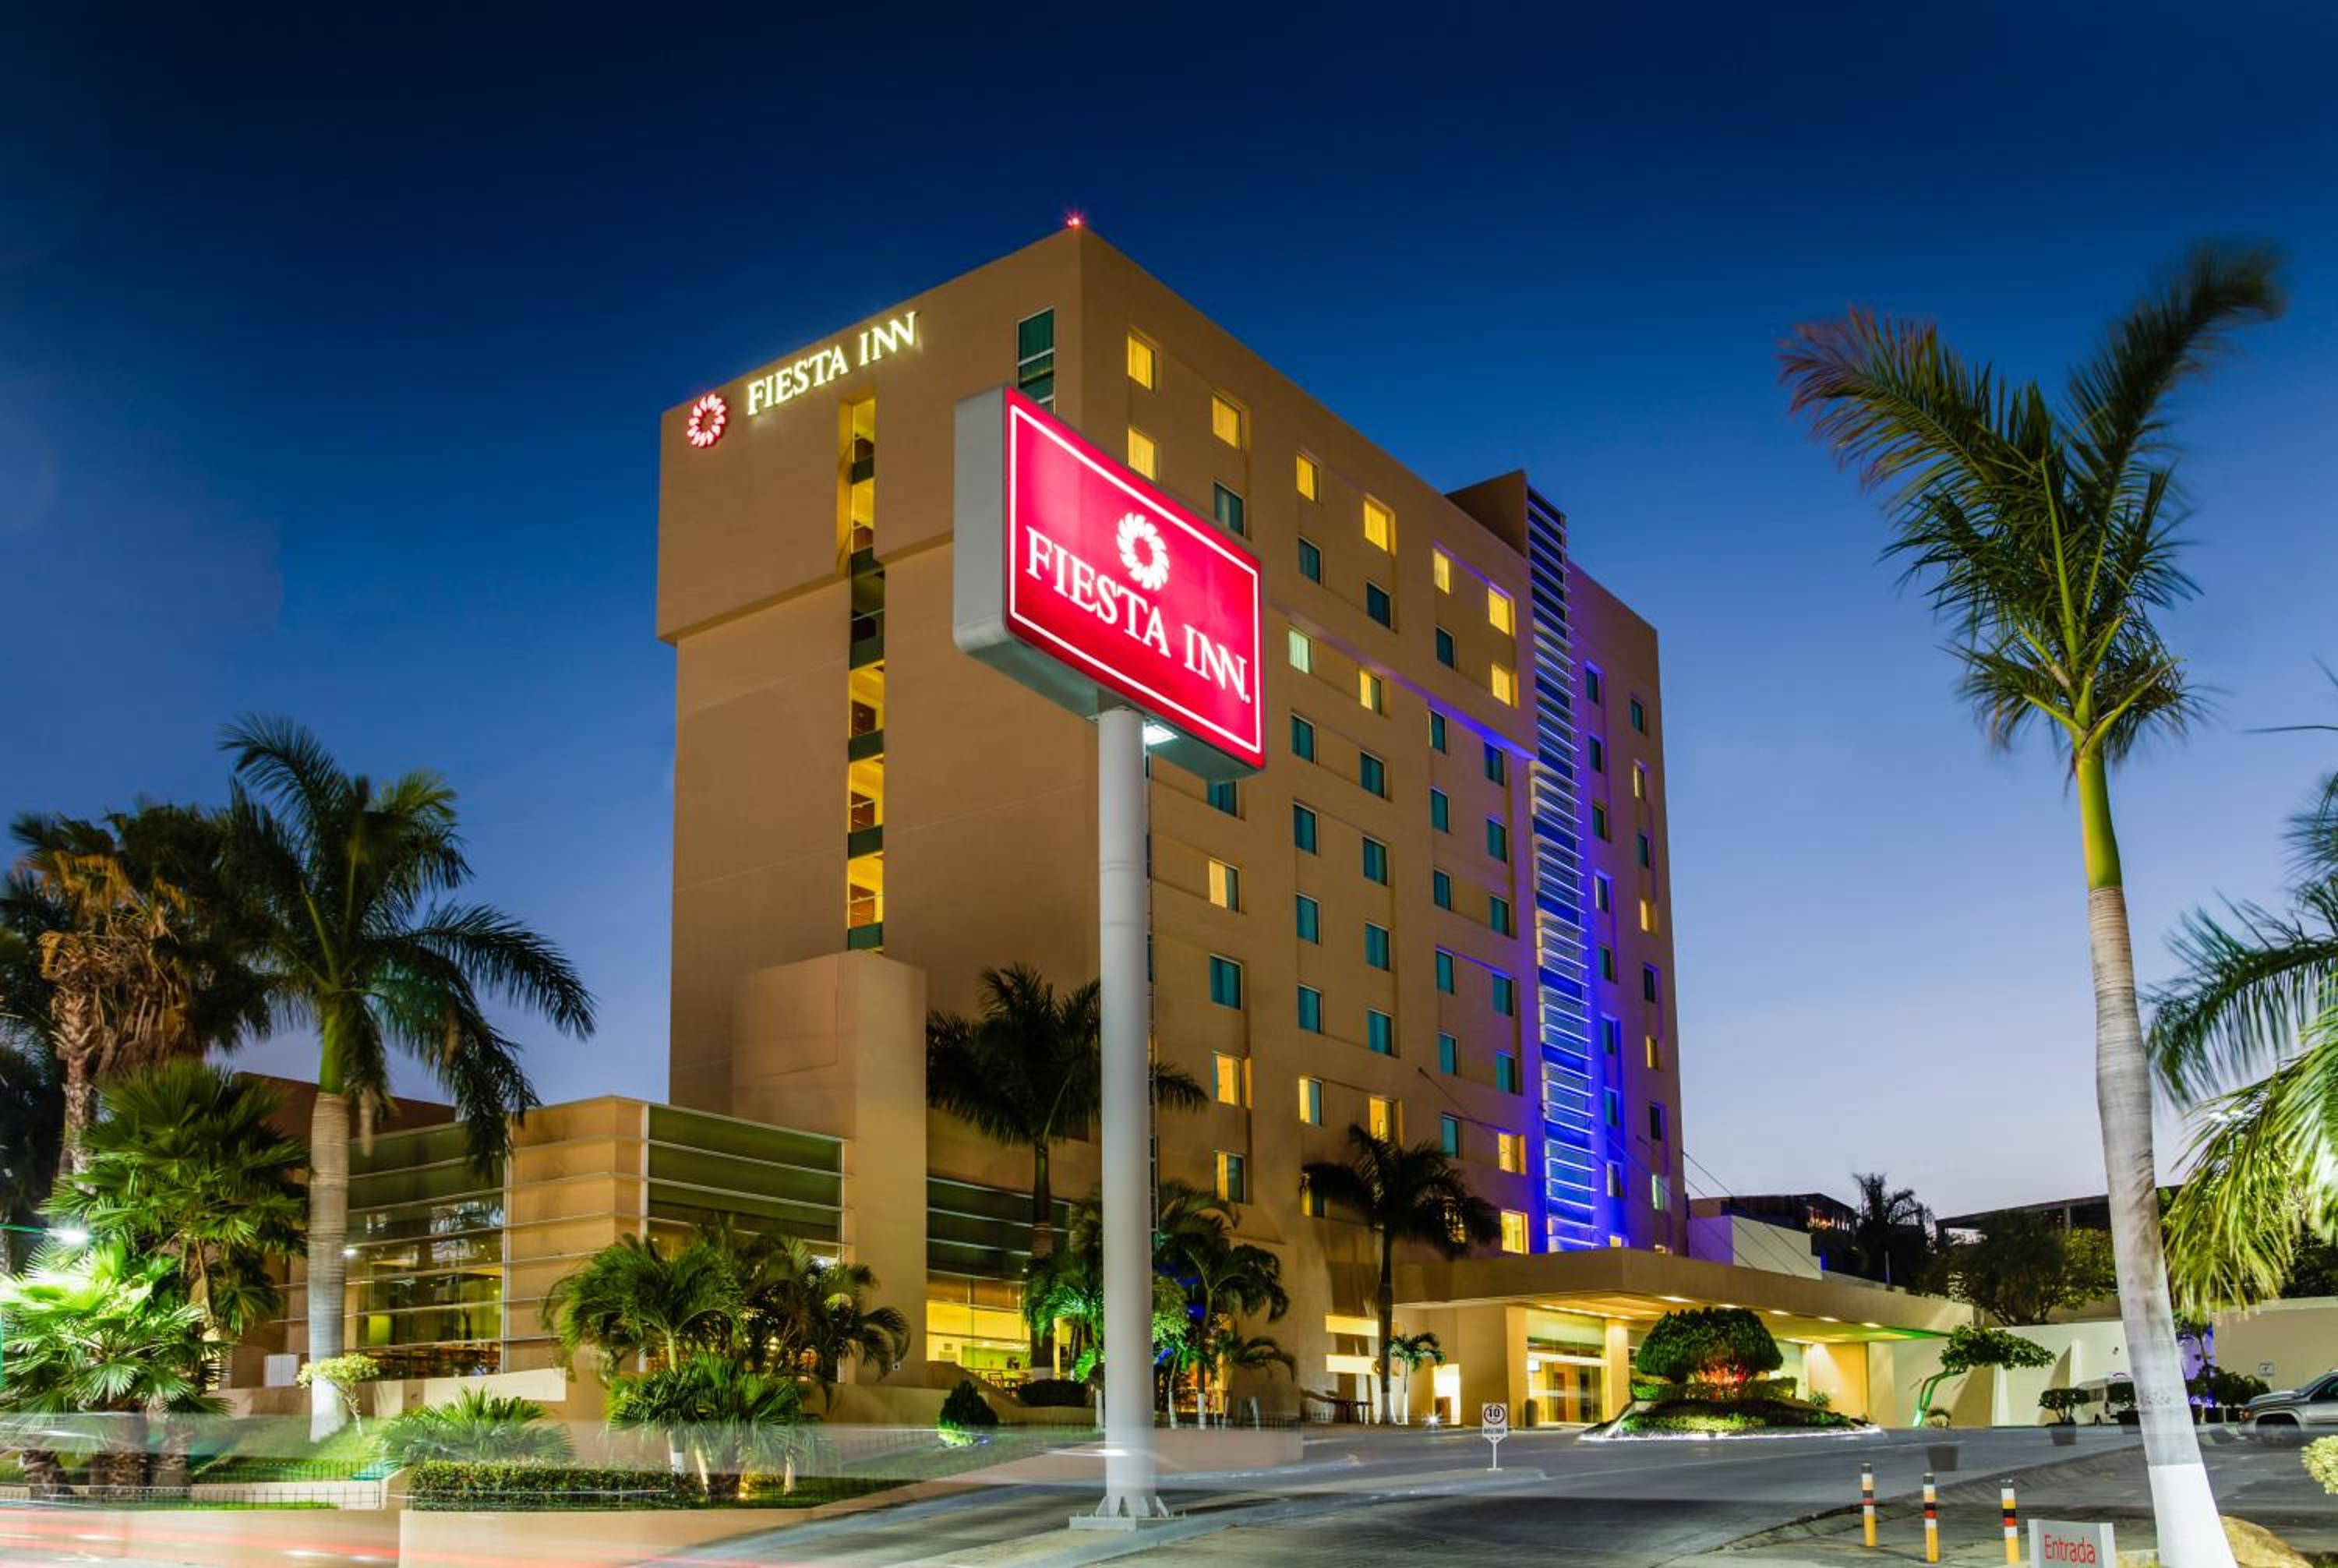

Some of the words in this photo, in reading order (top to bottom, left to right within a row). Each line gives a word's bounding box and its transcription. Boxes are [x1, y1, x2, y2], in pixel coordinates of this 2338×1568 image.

[747, 345, 849, 415] FIESTA
[859, 312, 915, 366] INN
[1026, 526, 1171, 659] FIESTA
[1489, 1408, 1500, 1418] 10
[2044, 1534, 2096, 1564] Entrada
